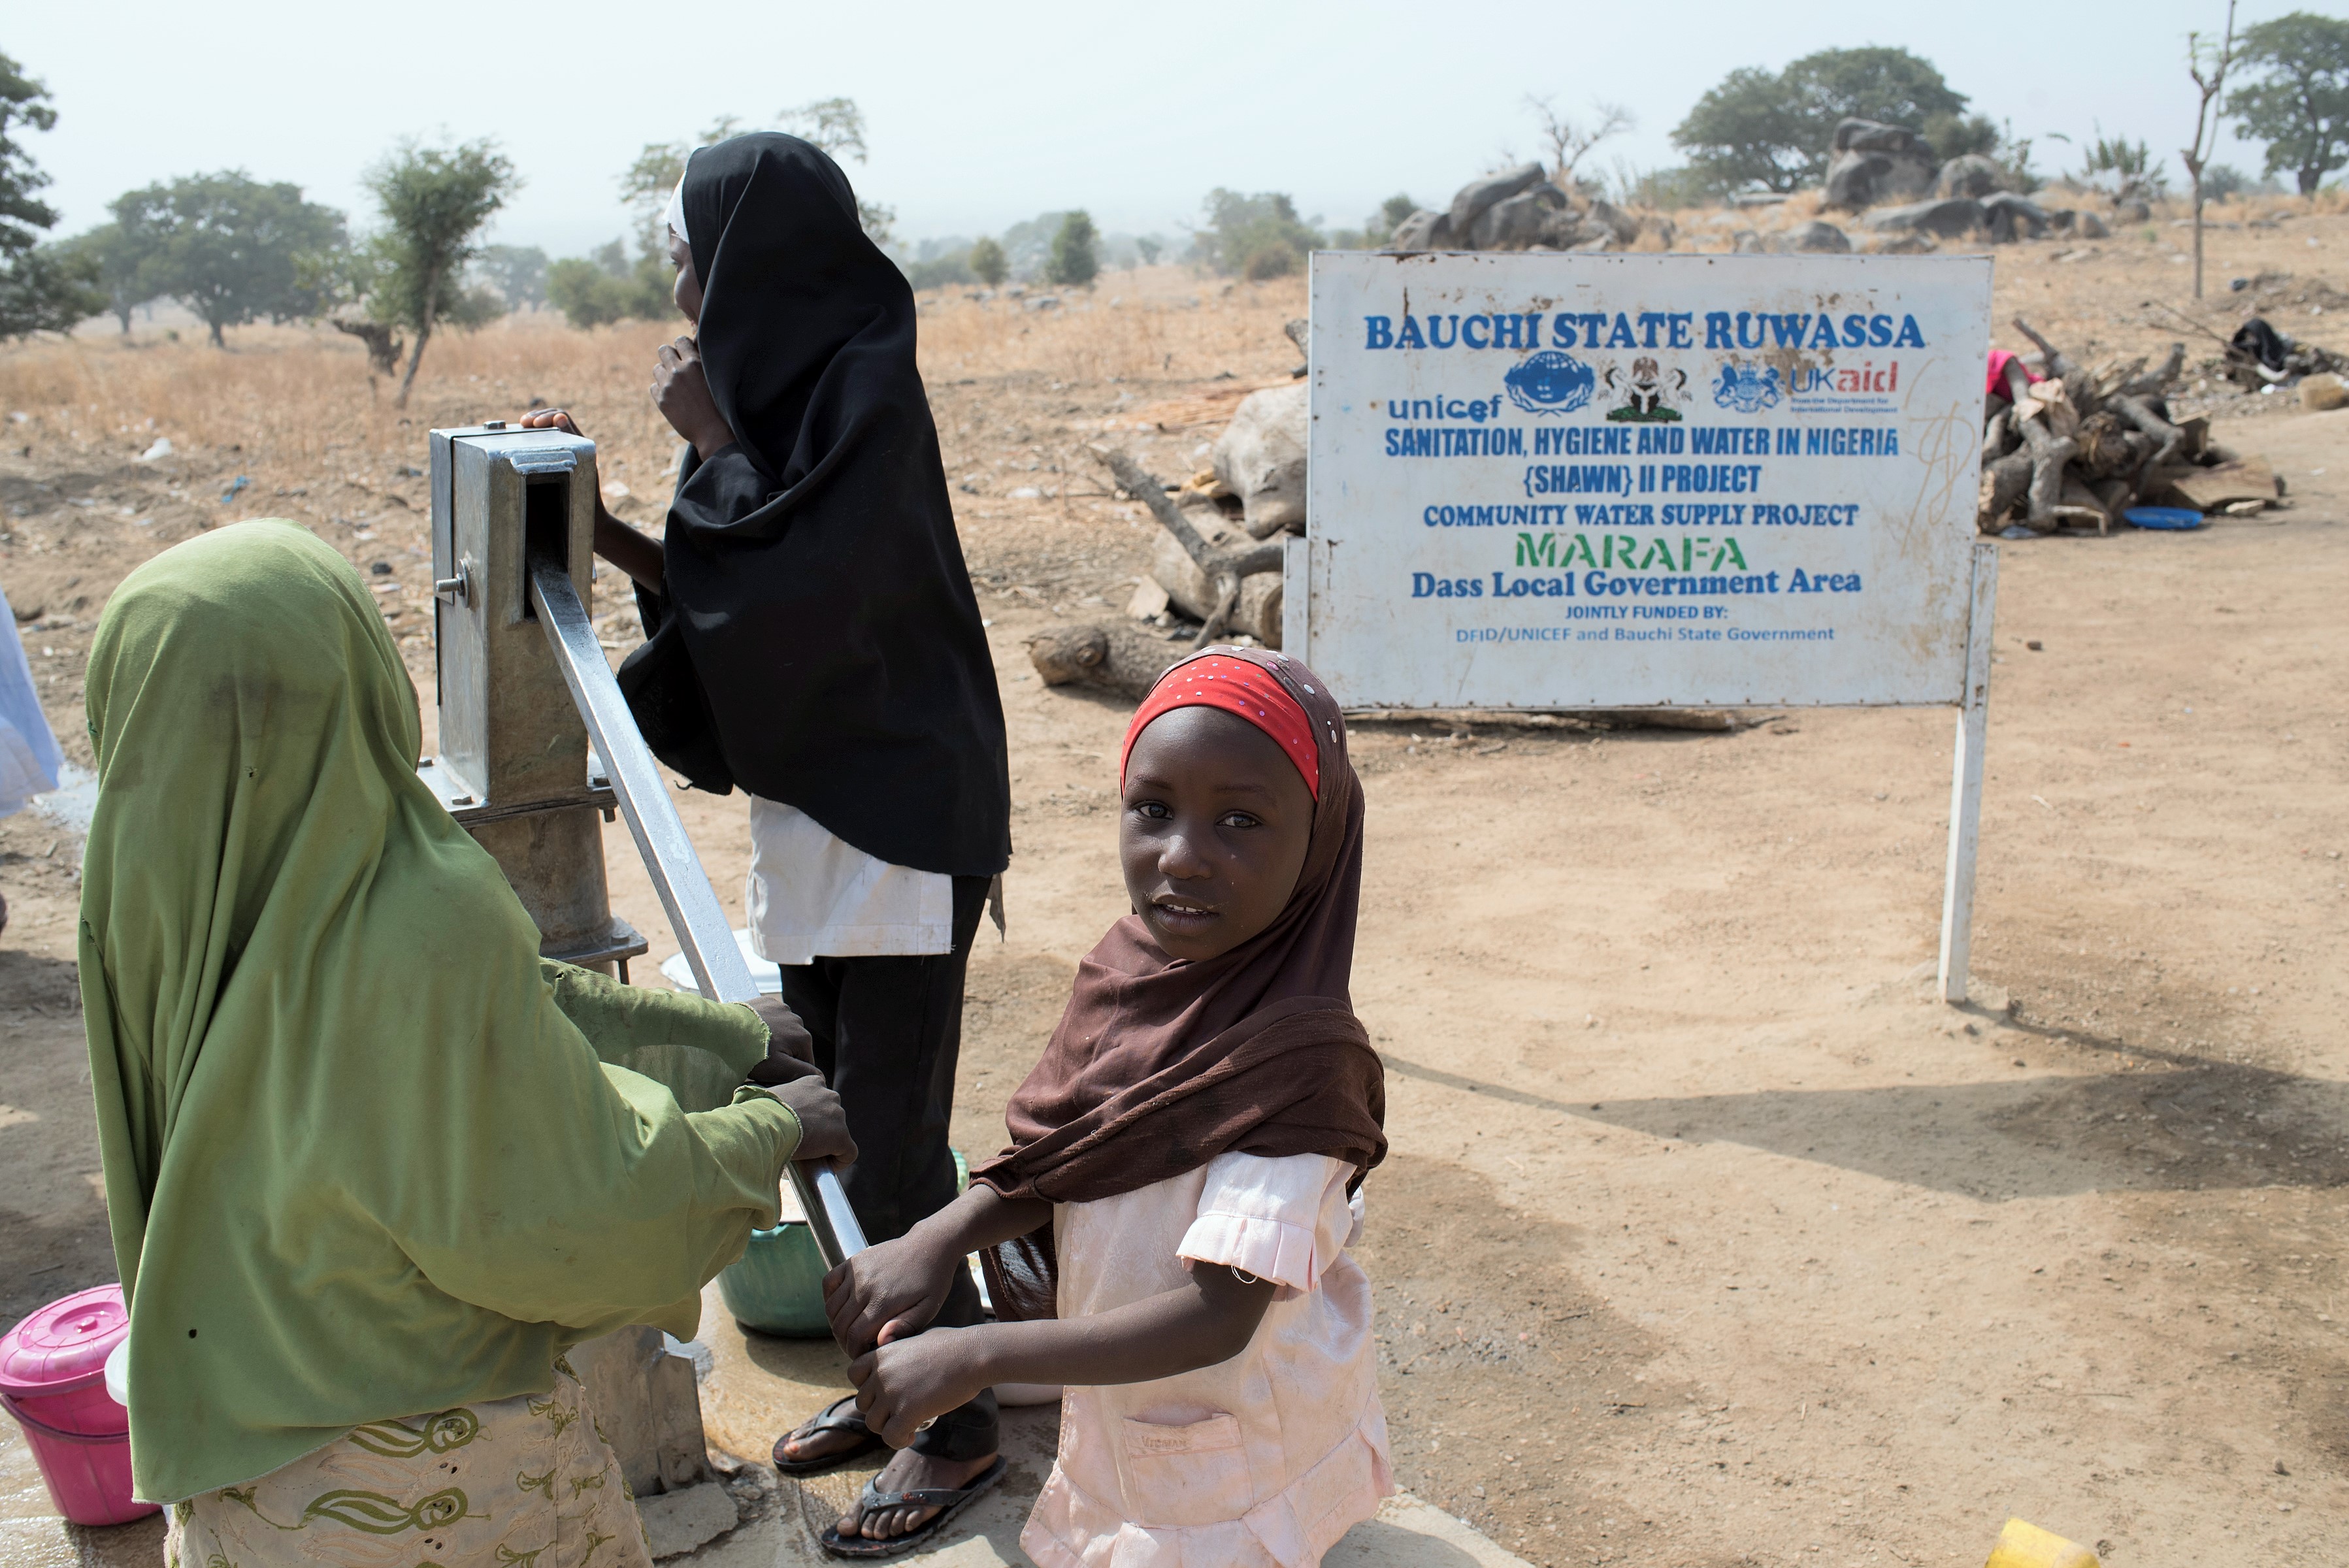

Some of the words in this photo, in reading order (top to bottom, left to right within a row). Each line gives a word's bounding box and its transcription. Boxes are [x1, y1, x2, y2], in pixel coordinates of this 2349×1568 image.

[1364, 314, 1543, 350] BAUCHI
[1552, 311, 1694, 350] STATE
[1704, 311, 1926, 350] RUWASSA
[1388, 394, 1503, 423] unicef
[1385, 427, 1528, 459] SANITATION,
[1534, 426, 1632, 456] HYGIENE
[1637, 426, 1686, 455] AND
[1691, 427, 1771, 455] WATER
[1777, 428, 1801, 455] IN
[1807, 427, 1899, 457] NIGERIA
[1523, 465, 1634, 498] {SHAWN}
[1639, 465, 1657, 493] II
[1662, 464, 1764, 493] PROJECT
[1423, 504, 1569, 527] COMMUNITY
[1575, 504, 1656, 526] WATER
[1662, 503, 1747, 527] SUPPLY
[1752, 503, 1860, 527] PROJECT
[1515, 532, 1749, 572] MARAFA
[1411, 572, 1484, 598] Dass
[1492, 571, 1576, 597] Local
[1584, 570, 1781, 596] Government
[1788, 568, 1862, 594] Area
[1565, 605, 1629, 620] JOINTLY
[1633, 605, 1698, 619] FUNDED
[1703, 605, 1728, 619] BY:
[1456, 627, 1571, 643] DFID/UNICEF
[1577, 628, 1609, 641] and
[1615, 627, 1673, 641] Bauchi
[1678, 627, 1723, 641] State
[1726, 627, 1835, 642] Government
